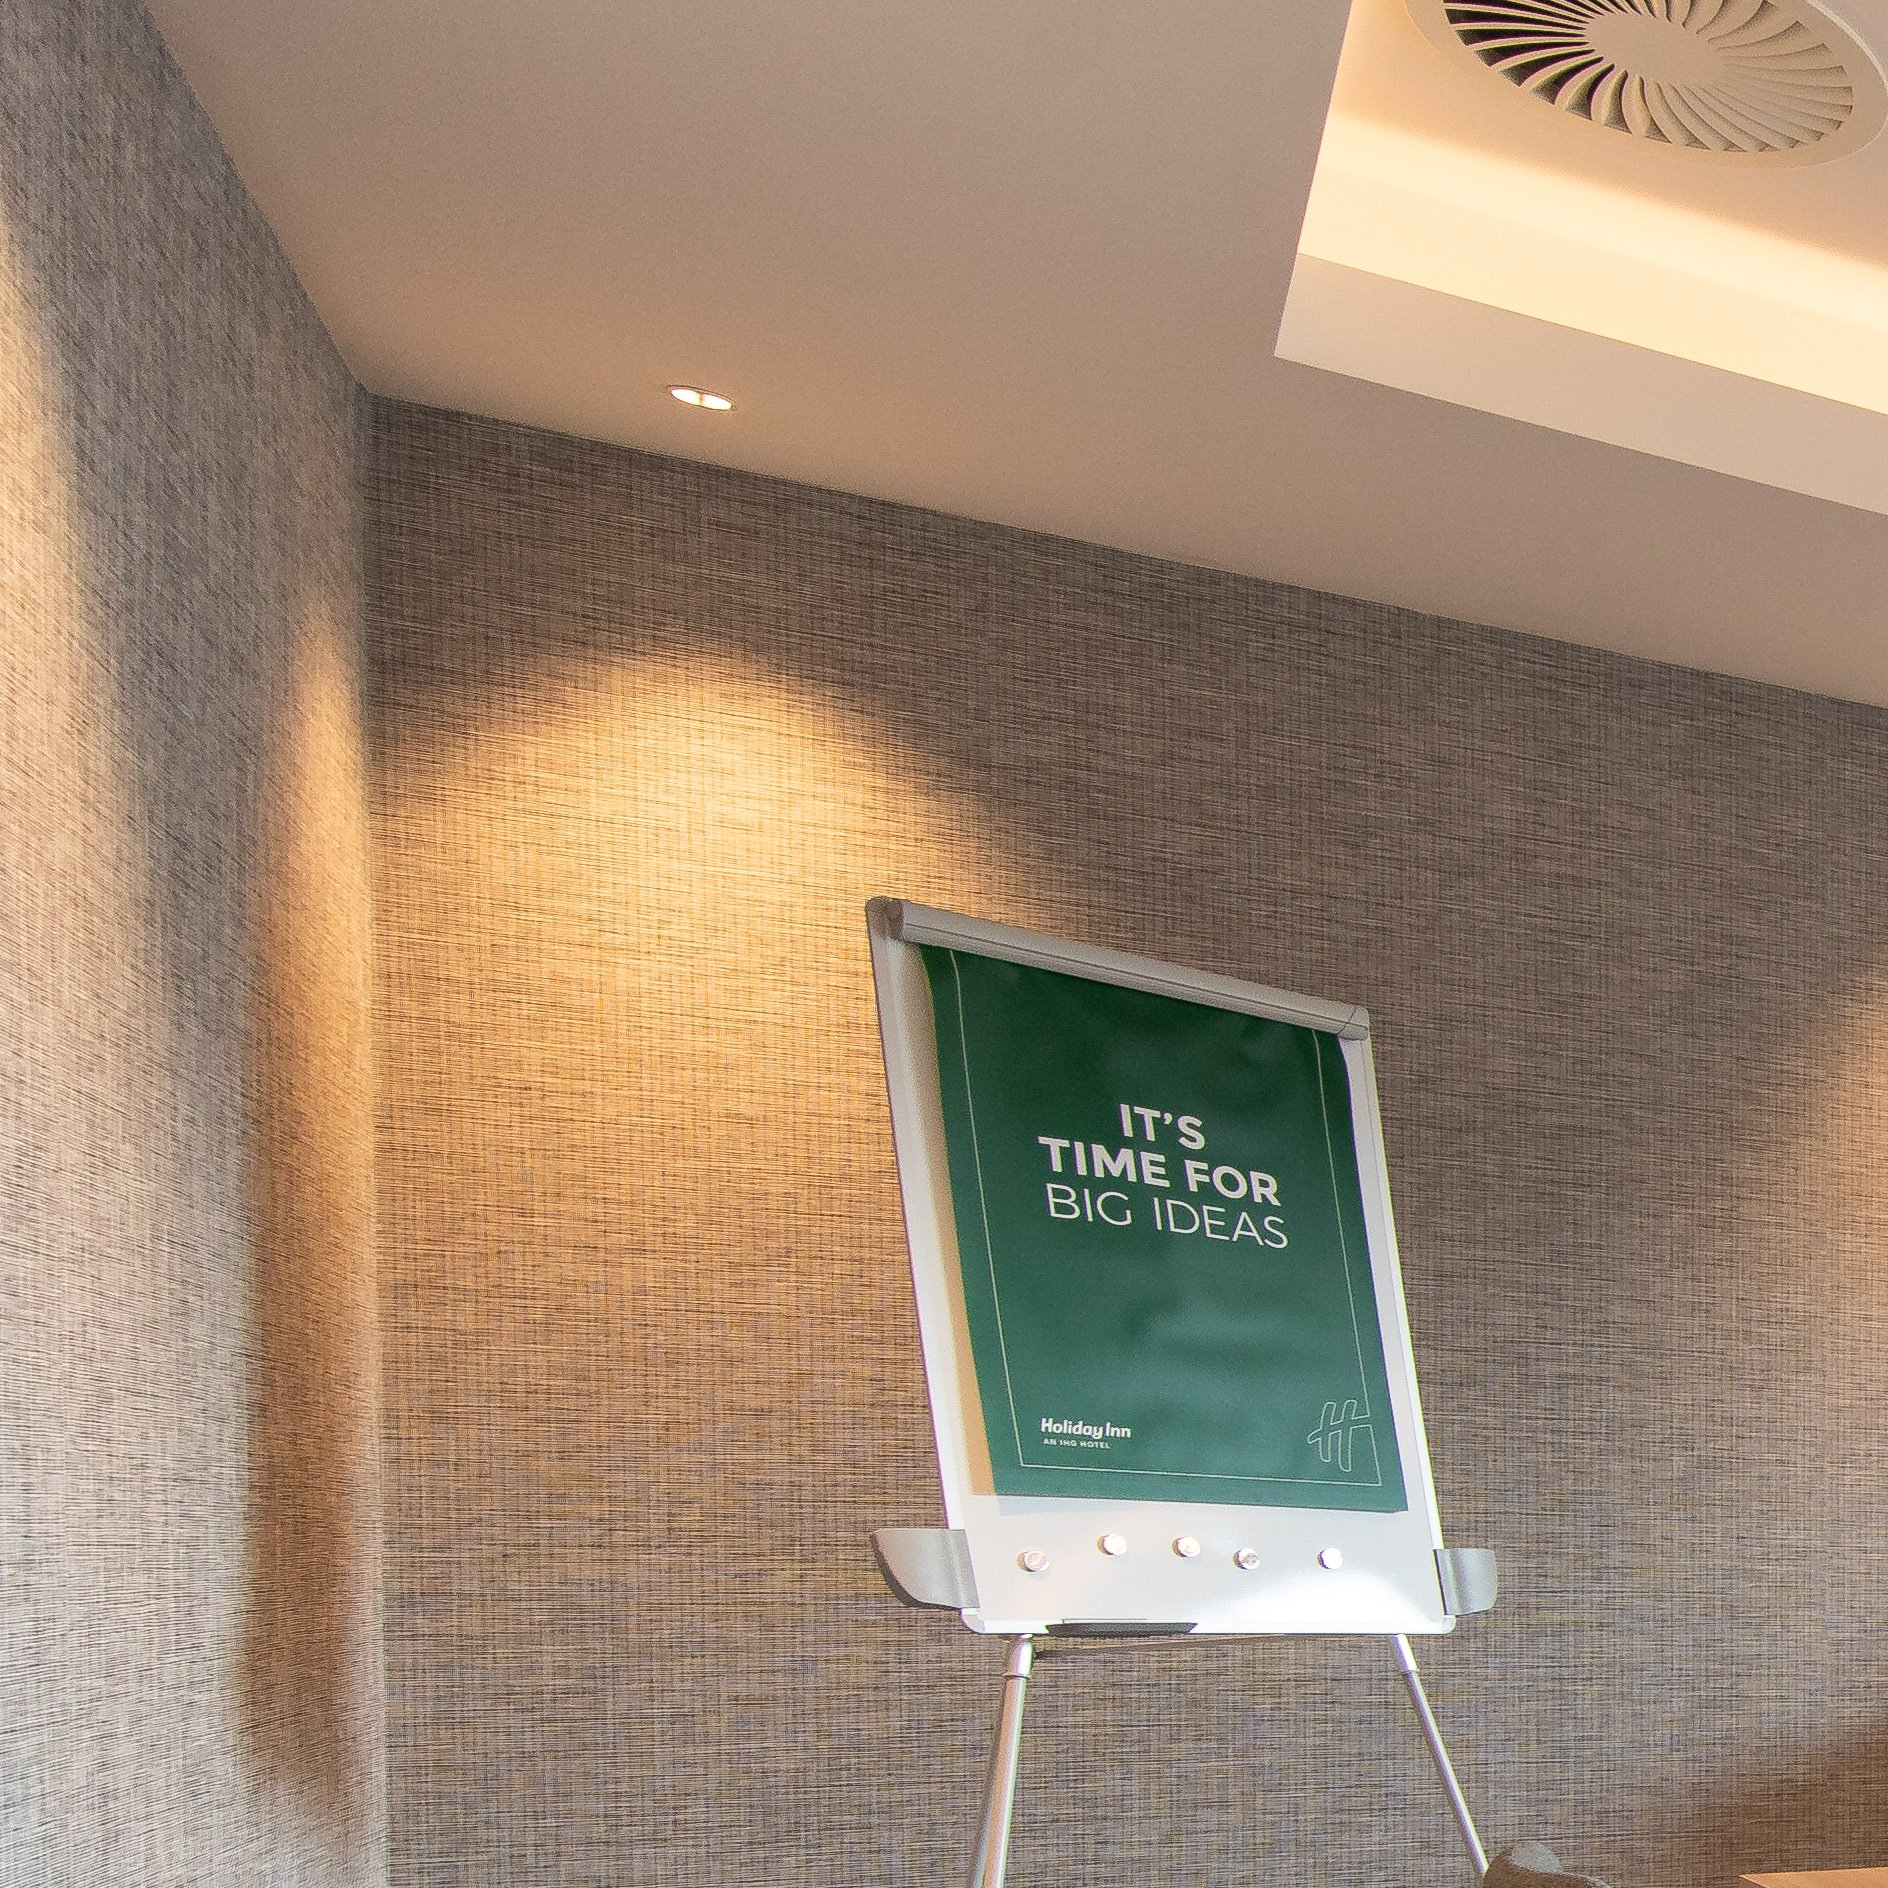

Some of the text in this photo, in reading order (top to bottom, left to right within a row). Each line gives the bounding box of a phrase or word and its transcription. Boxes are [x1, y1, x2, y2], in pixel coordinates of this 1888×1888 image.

[1037, 1136, 1282, 1207] TIME FOR
[1046, 1182, 1289, 1249] BIG IDEAS
[1041, 1417, 1132, 1440] Holiday Inn
